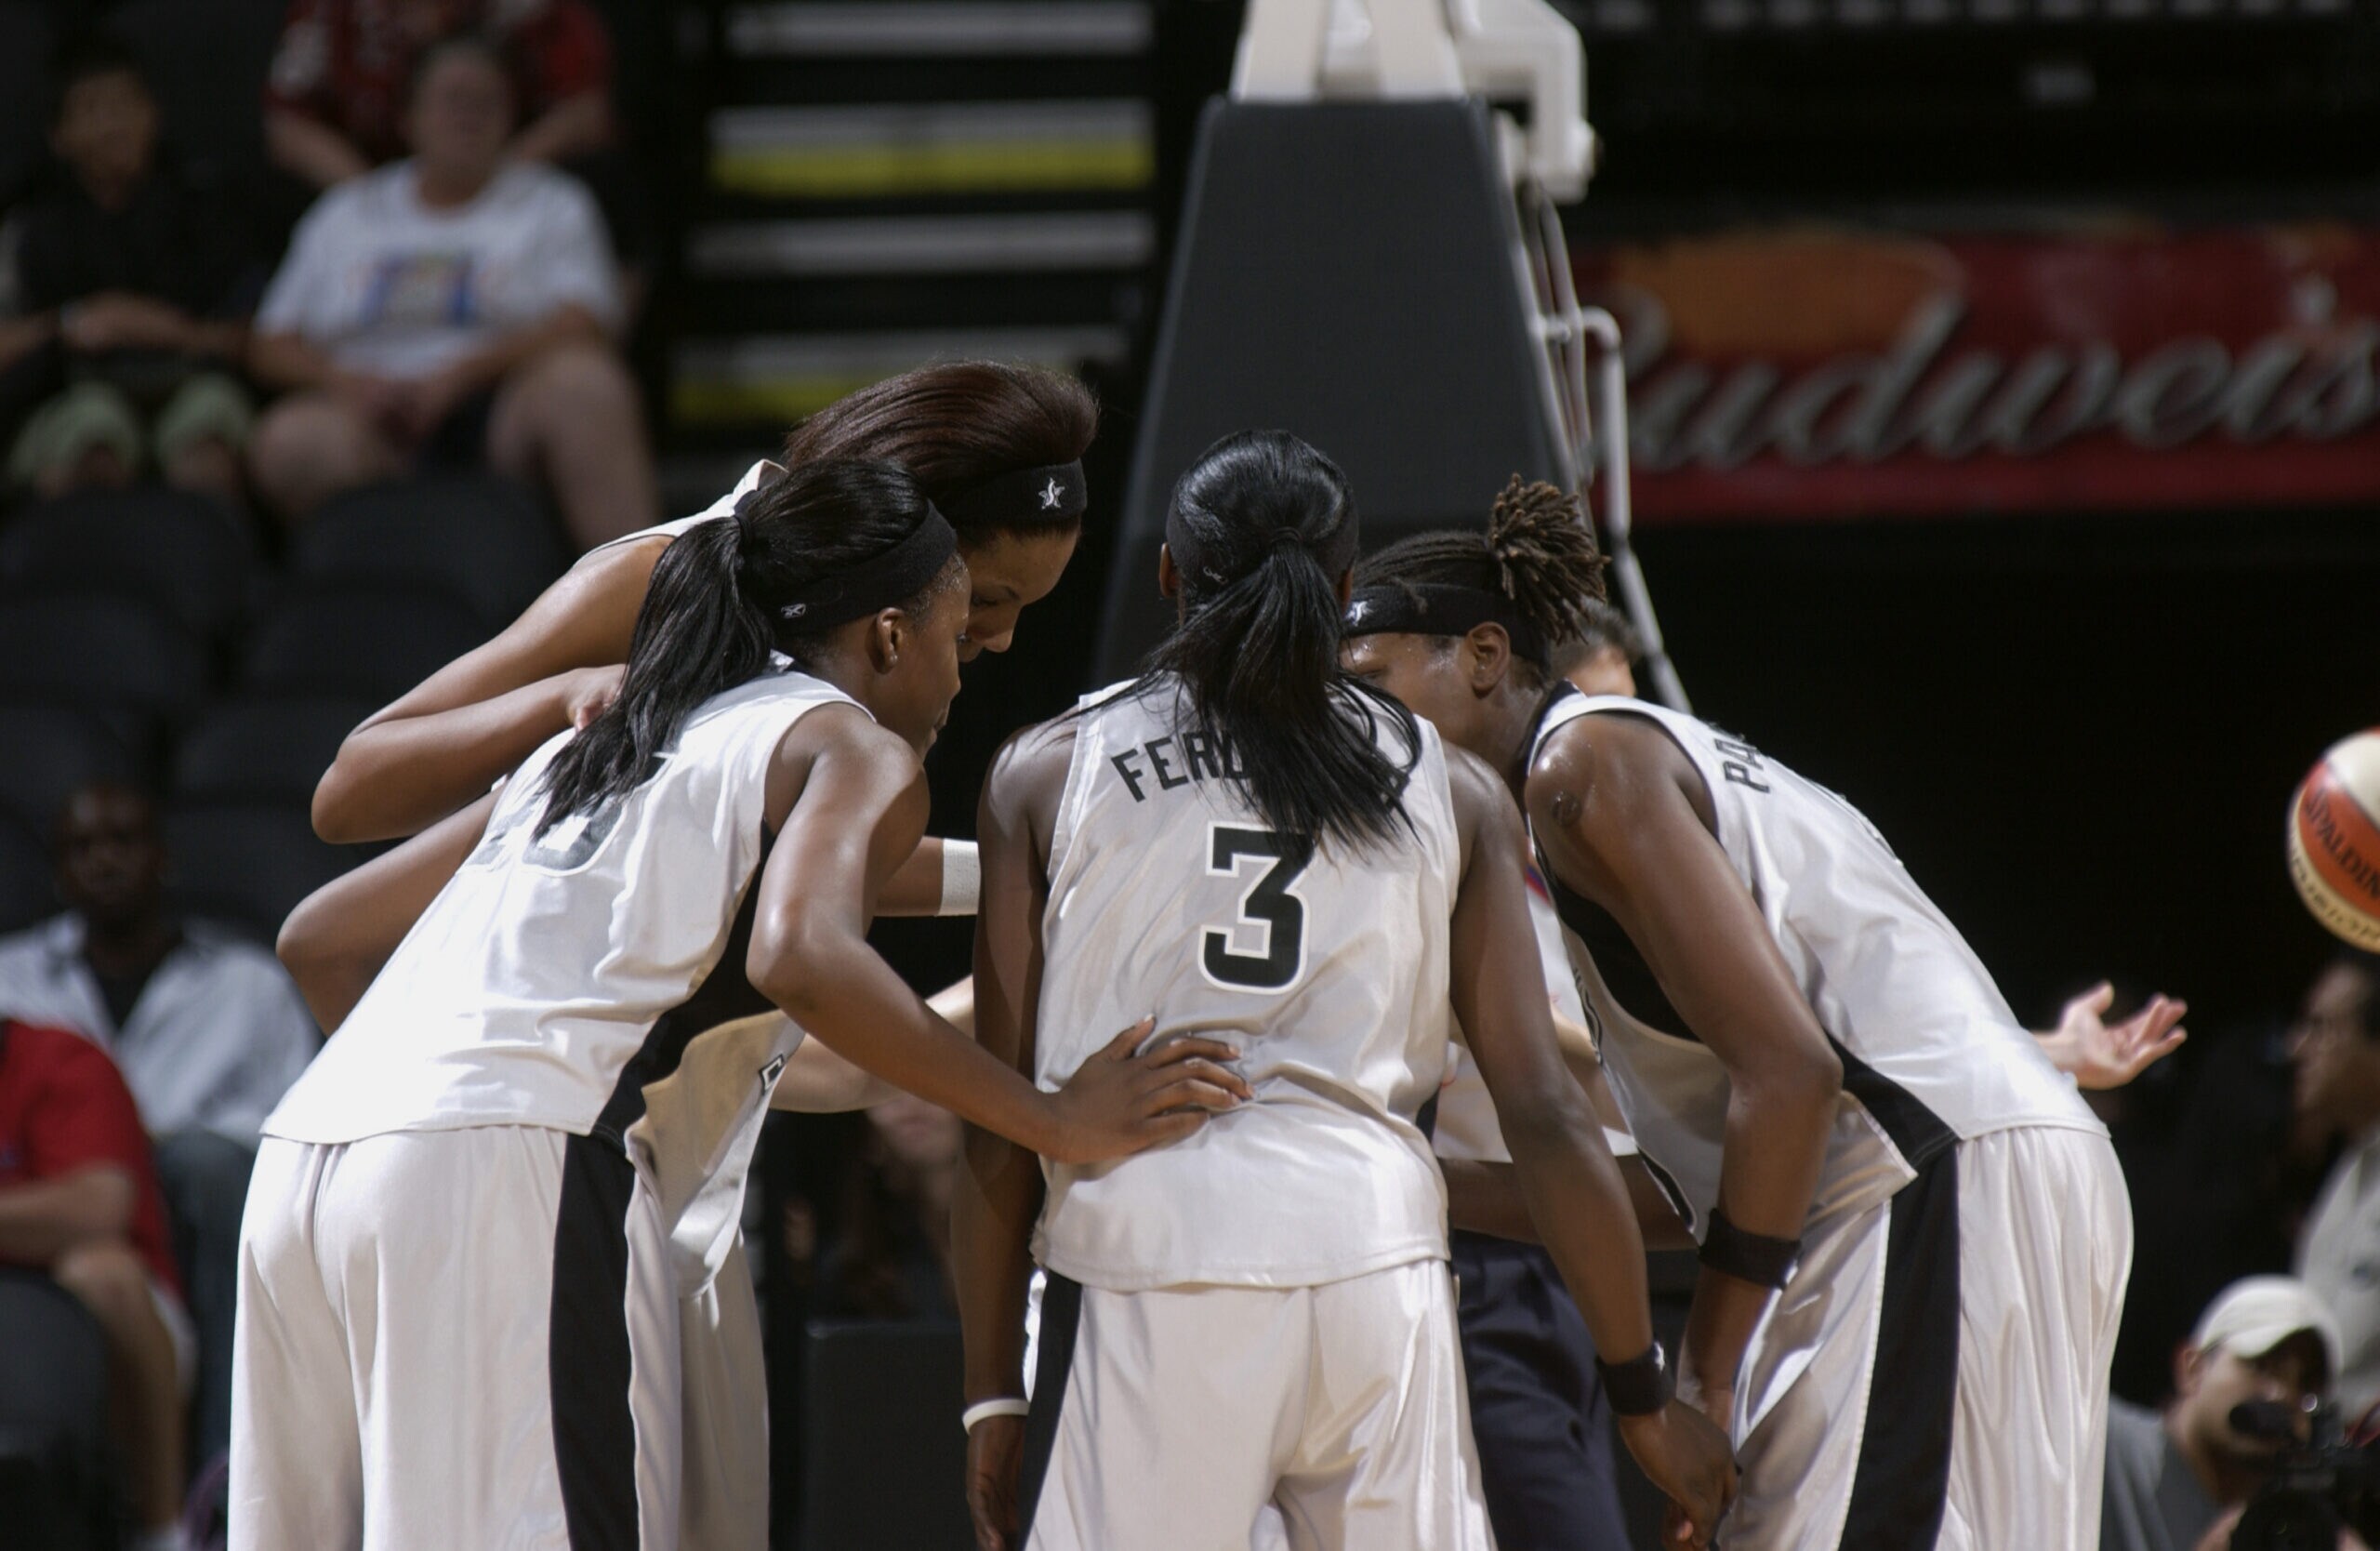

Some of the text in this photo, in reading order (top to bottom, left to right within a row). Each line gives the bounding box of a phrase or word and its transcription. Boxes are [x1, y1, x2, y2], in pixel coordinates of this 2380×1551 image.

[1110, 729, 1253, 803] FERD
[1712, 735, 1771, 794] PA
[1198, 821, 1311, 995] 3
